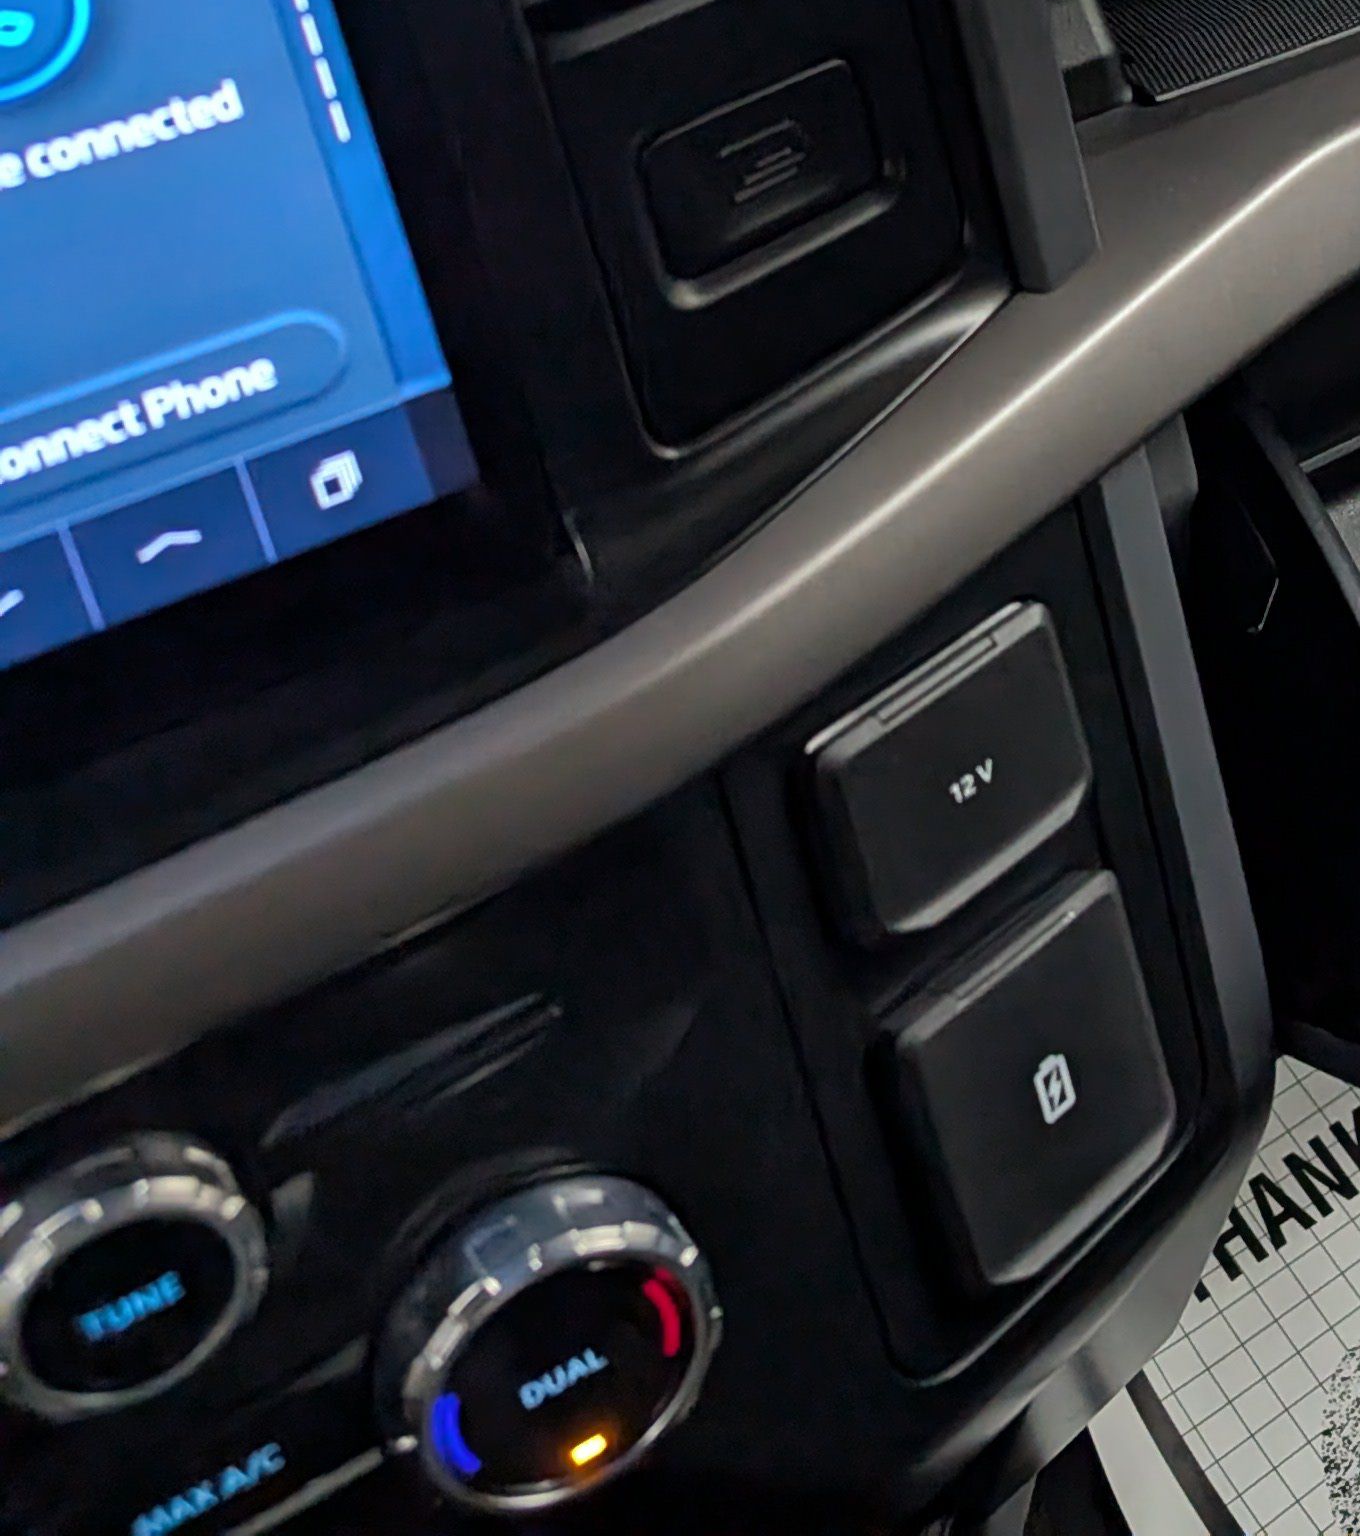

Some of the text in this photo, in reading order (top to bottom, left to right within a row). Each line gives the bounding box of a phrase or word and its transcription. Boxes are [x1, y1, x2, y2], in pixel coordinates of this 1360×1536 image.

[24, 77, 245, 181] connected
[0, 356, 279, 486] onnect Phone
[948, 757, 993, 804] 12 V
[74, 1269, 187, 1342] TUNE
[517, 1348, 610, 1411] DUAL
[131, 1478, 219, 1536] MAX
